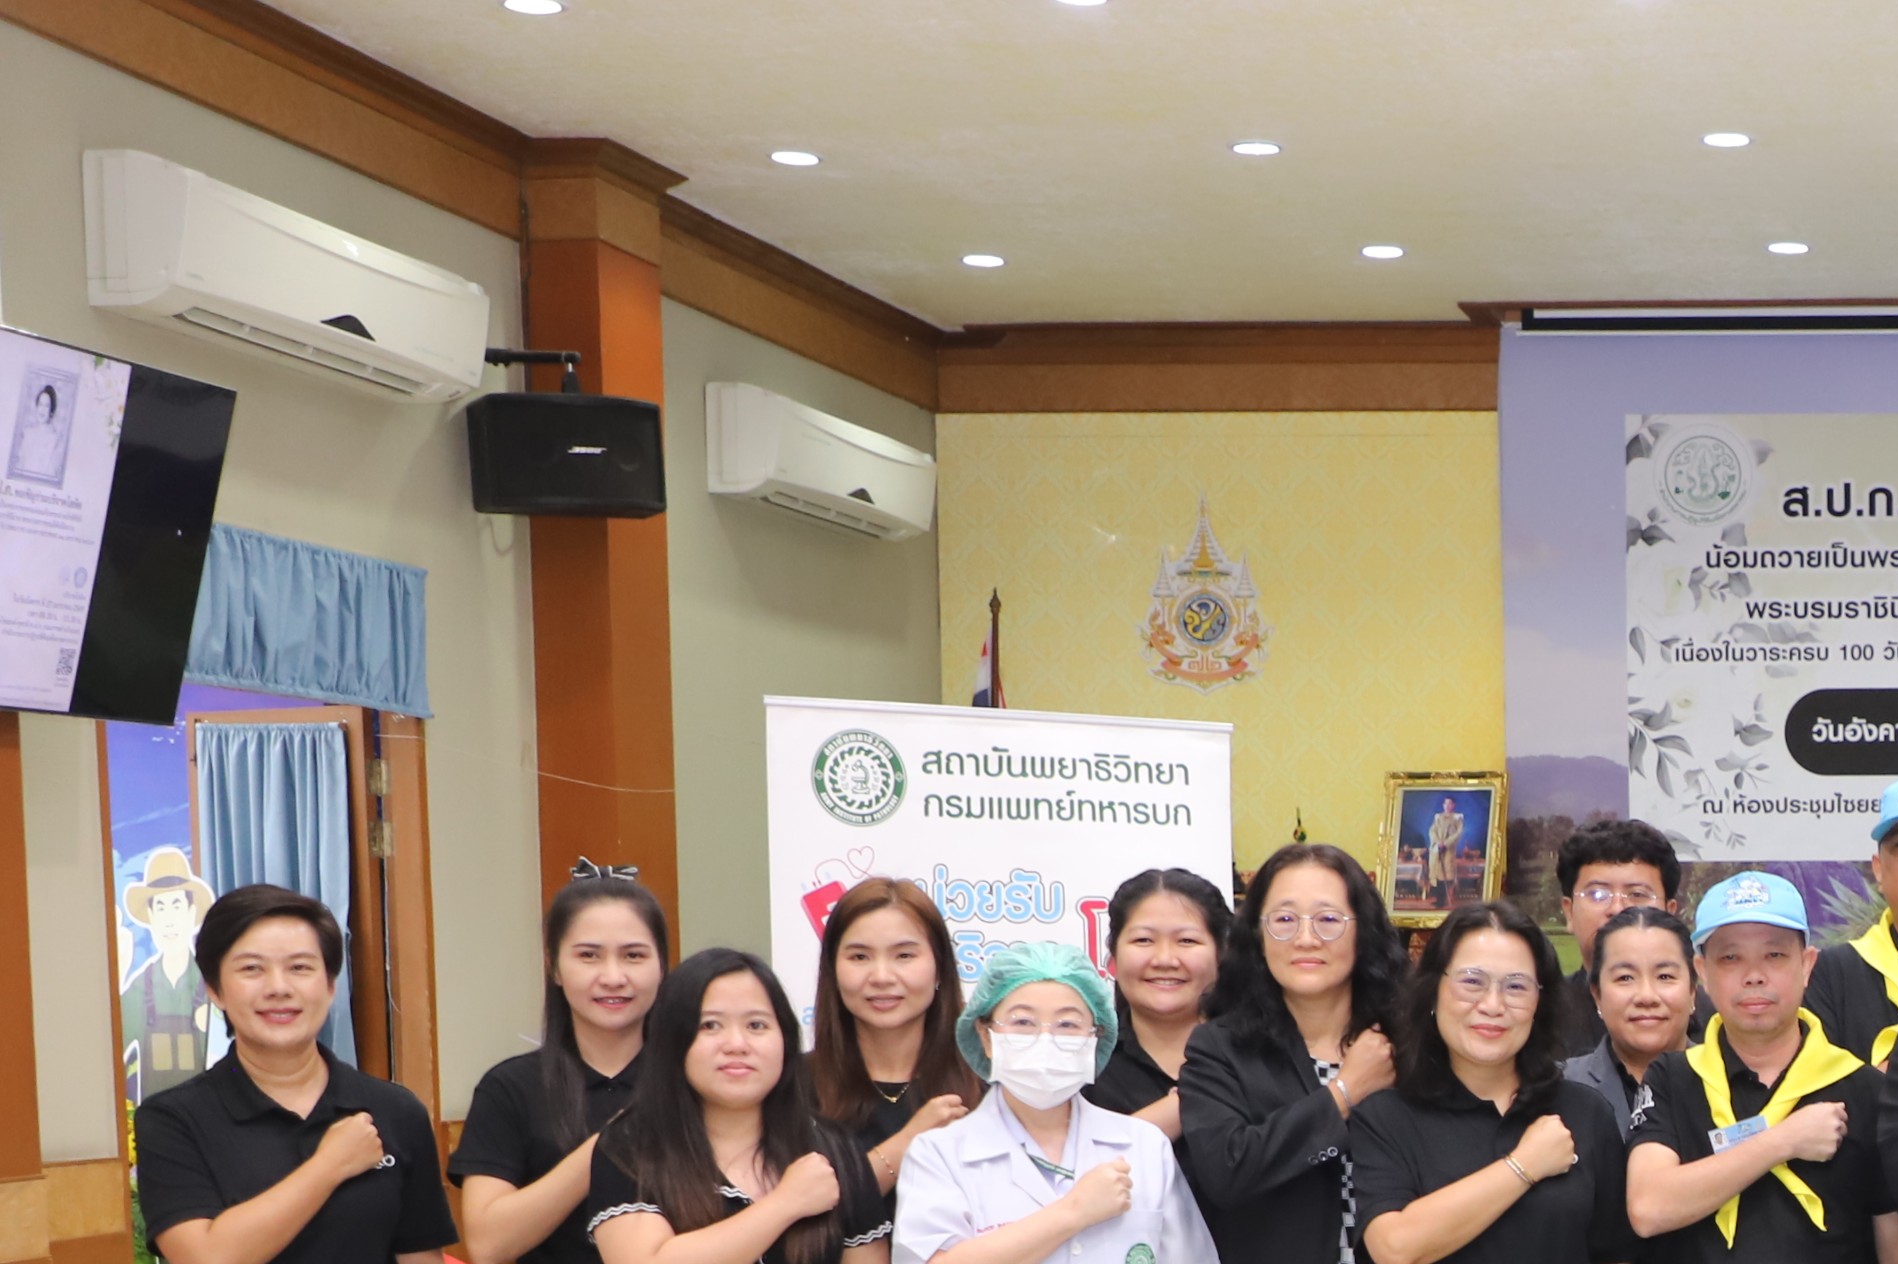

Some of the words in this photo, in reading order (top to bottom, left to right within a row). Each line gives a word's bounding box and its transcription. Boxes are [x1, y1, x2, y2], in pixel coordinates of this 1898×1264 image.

[1674, 637, 1829, 662] เนื่องในวาระครบ
[1839, 643, 1874, 661] 100
[921, 746, 1190, 786] สถาบันพยาธิวิทยา
[923, 790, 1192, 826] กรมแพทย์ทหารบก
[1702, 796, 1724, 814] ณ
